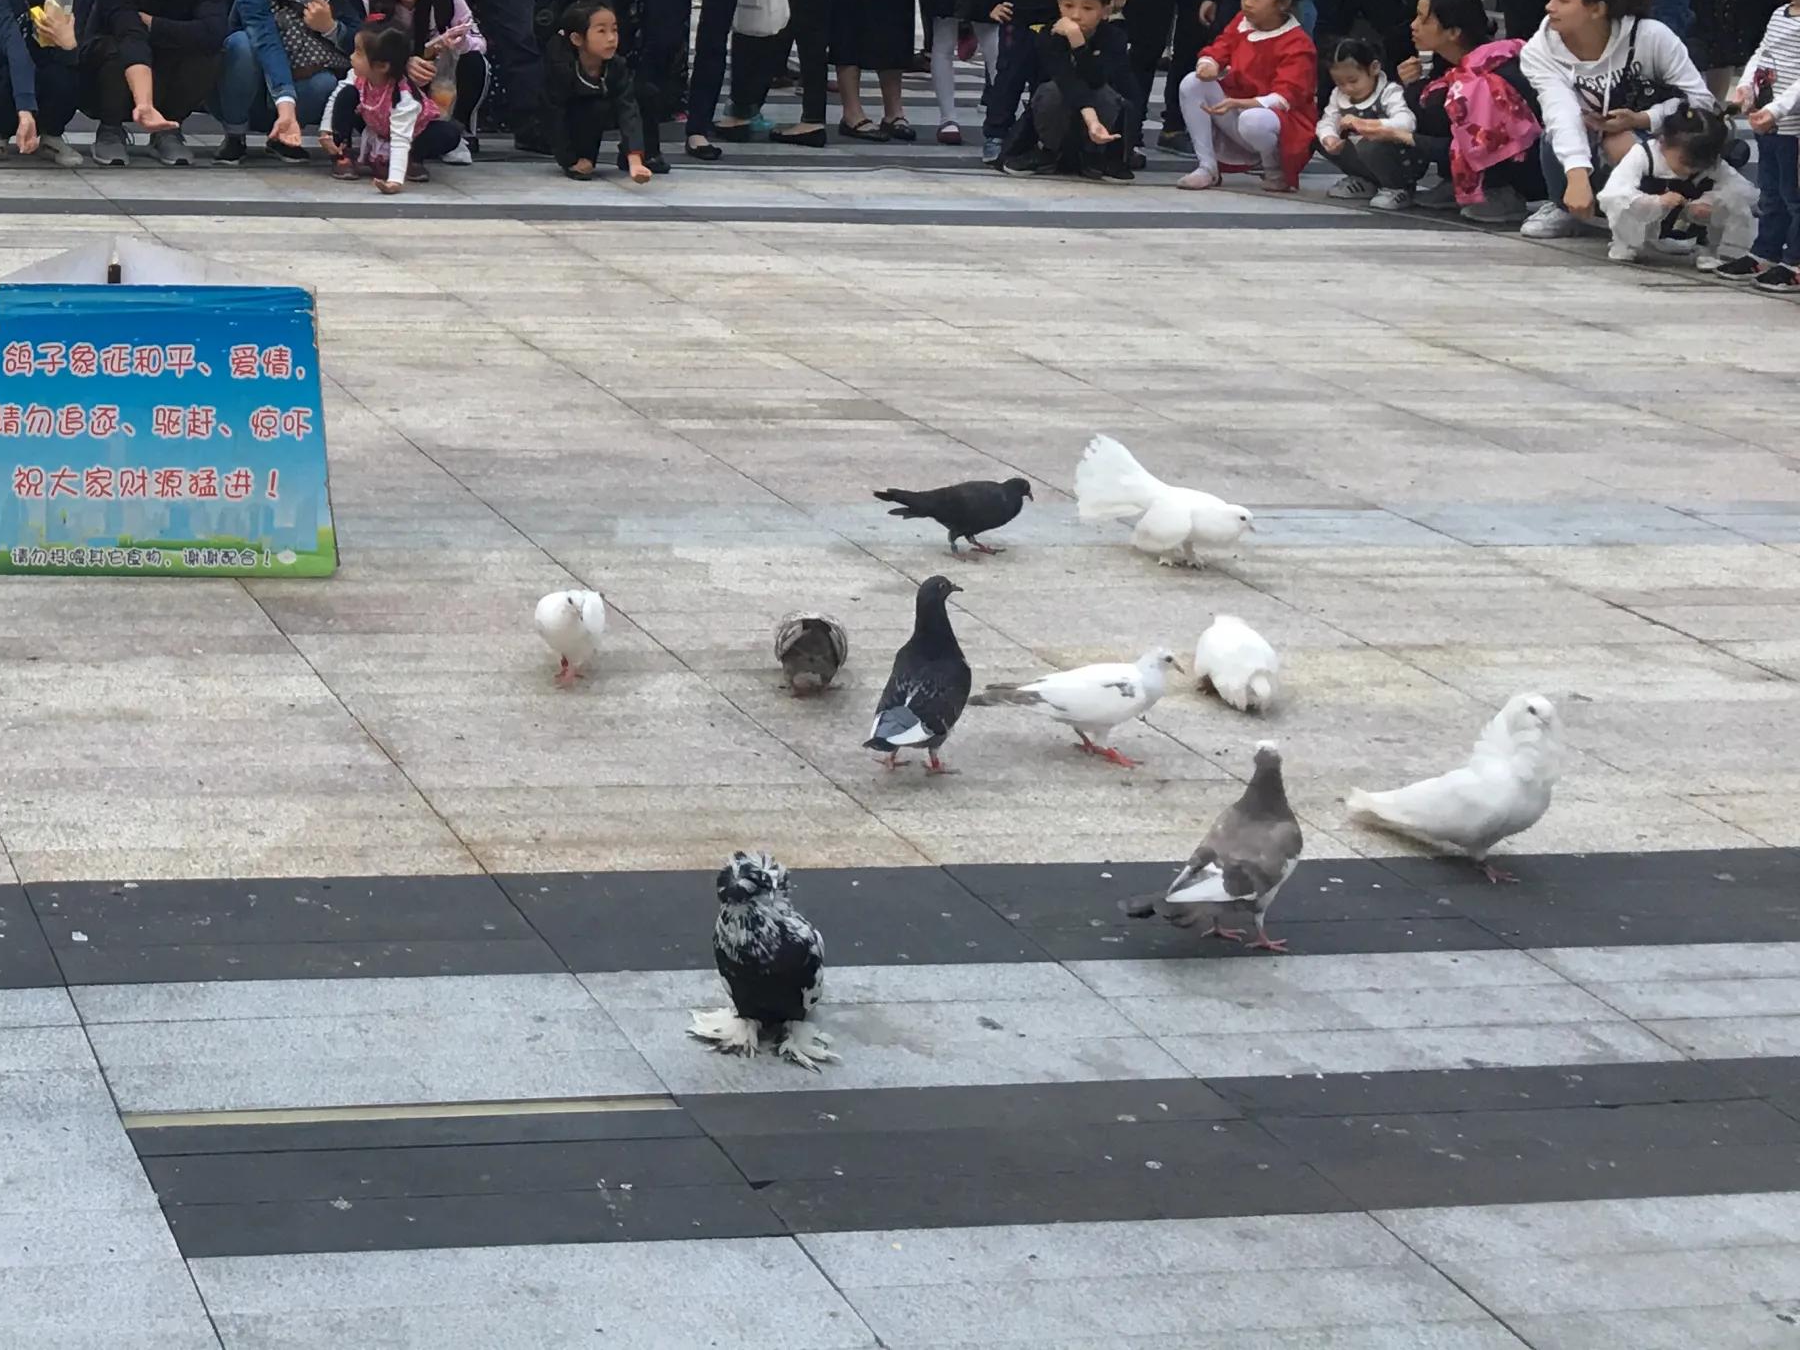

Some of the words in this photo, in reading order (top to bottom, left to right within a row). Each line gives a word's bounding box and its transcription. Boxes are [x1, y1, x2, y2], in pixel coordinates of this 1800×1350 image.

[13, 466, 280, 500] 祝大家财源猛进！
